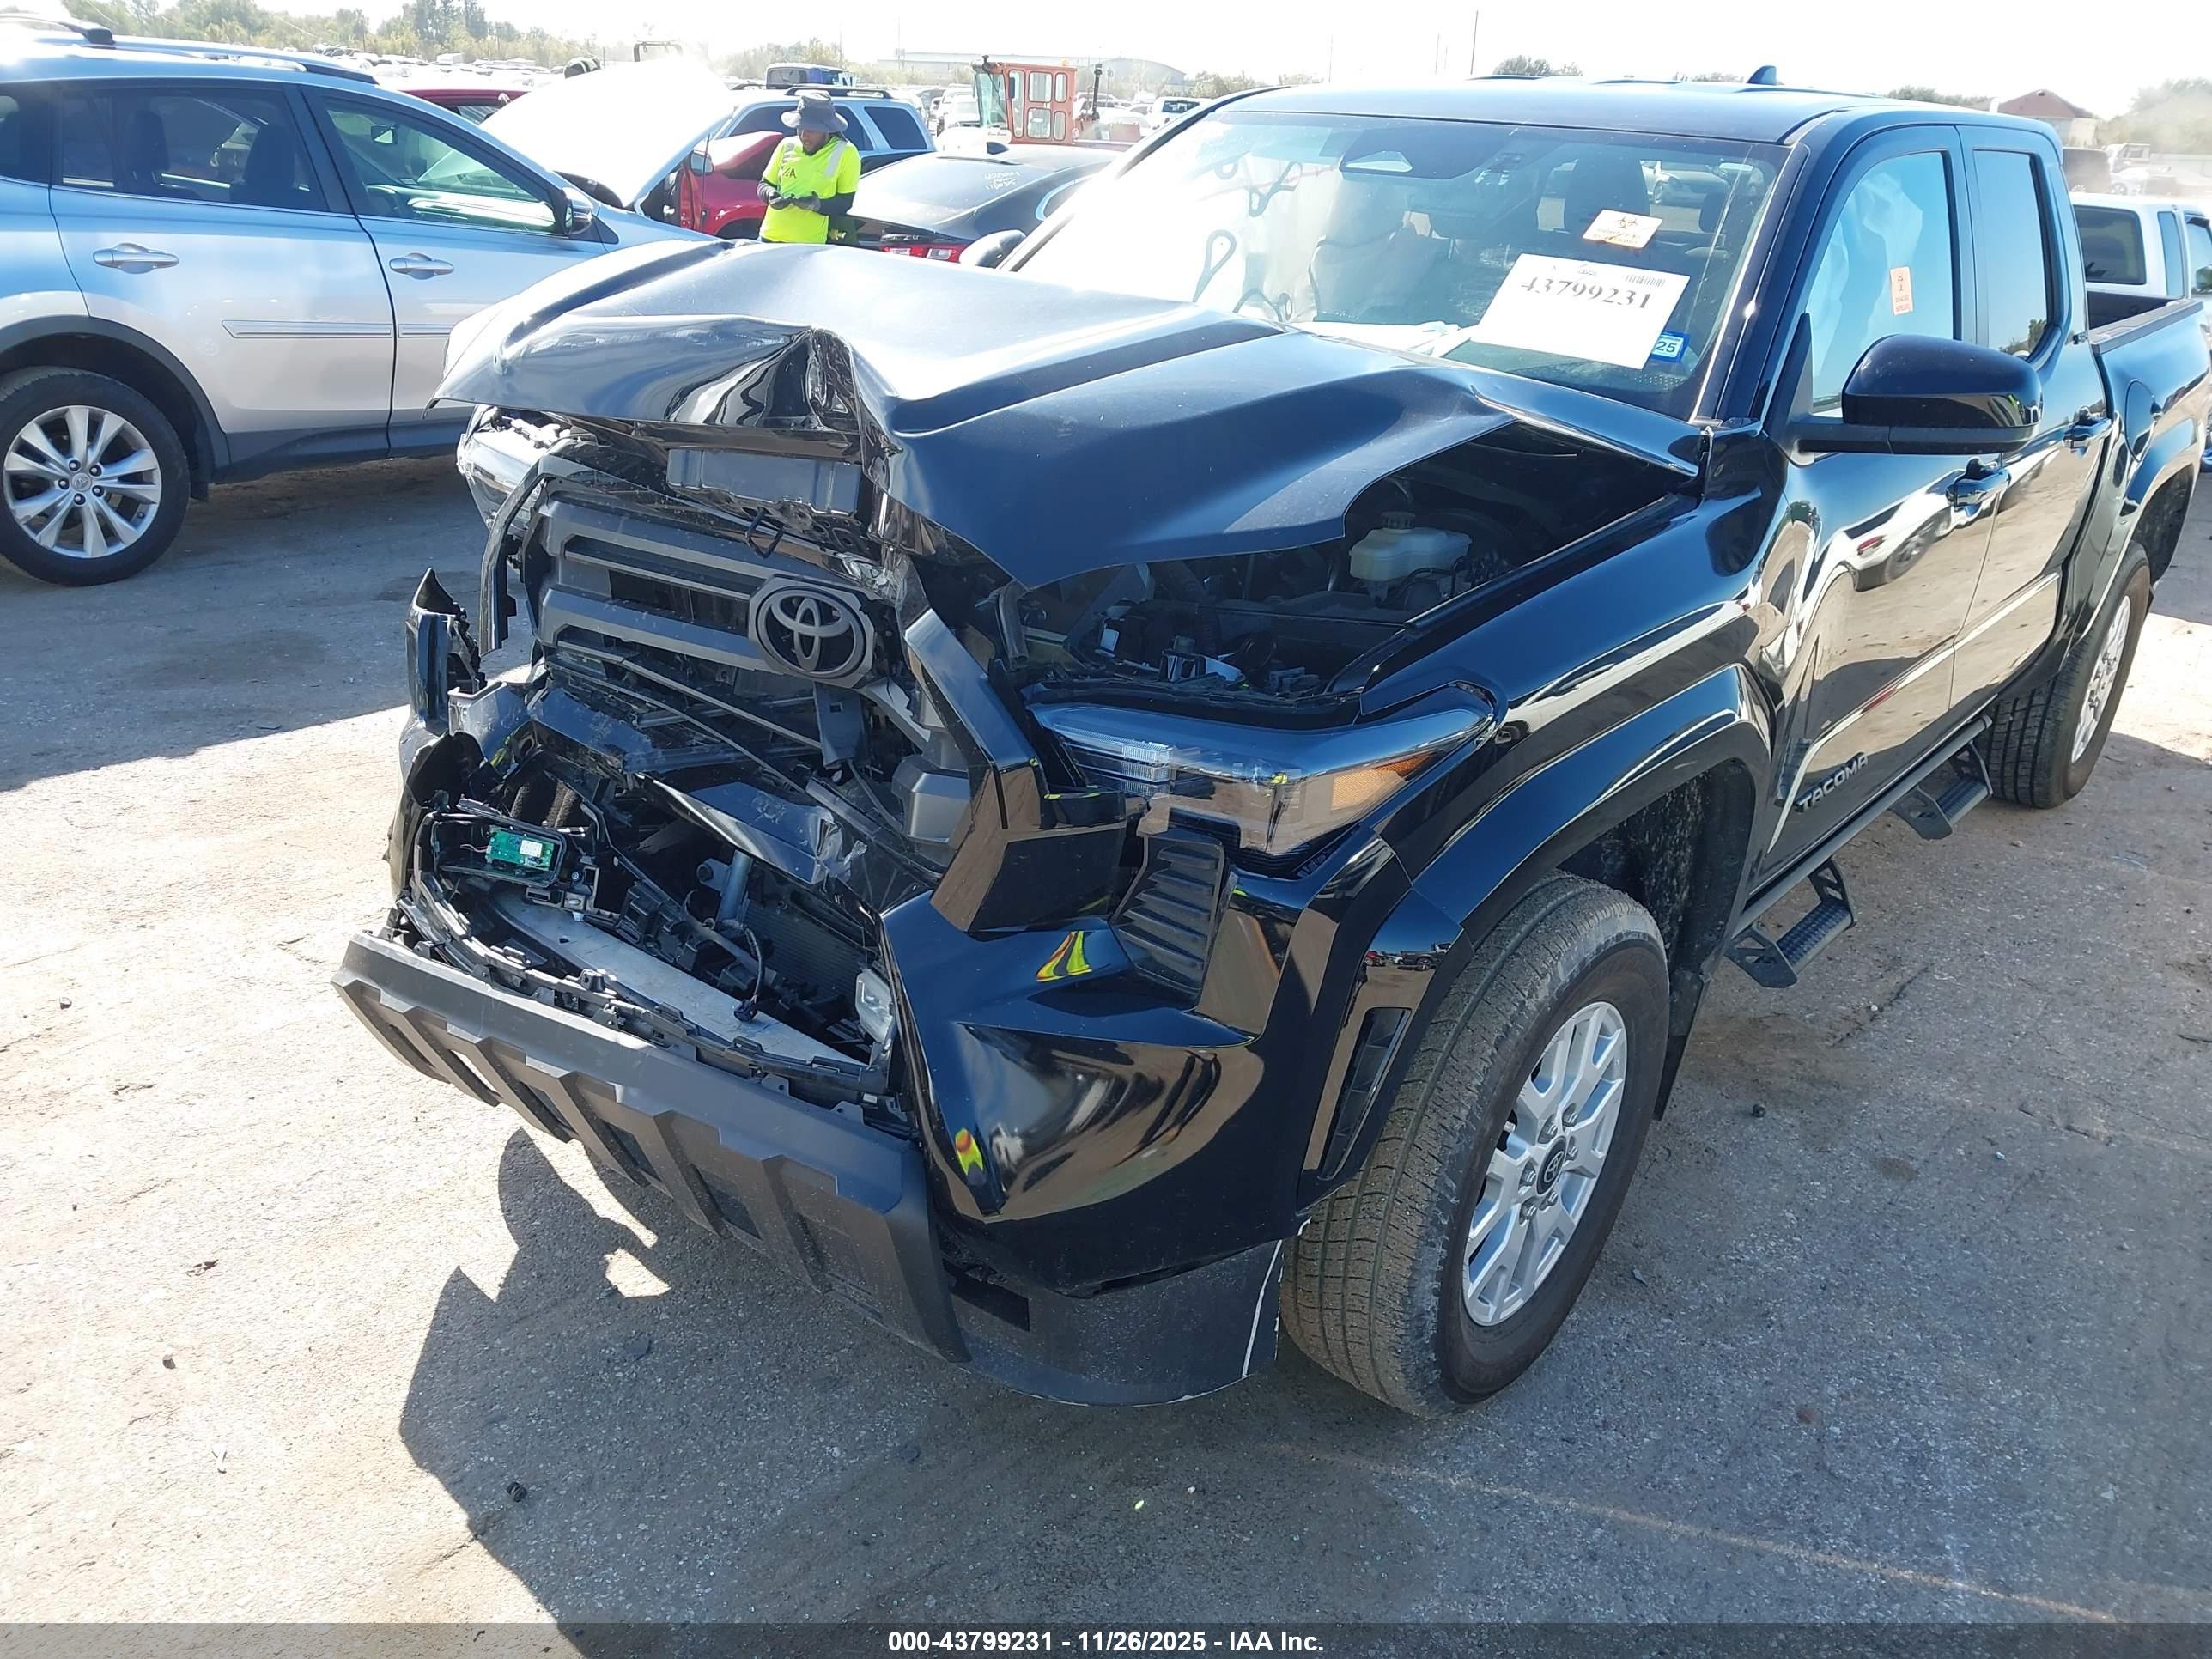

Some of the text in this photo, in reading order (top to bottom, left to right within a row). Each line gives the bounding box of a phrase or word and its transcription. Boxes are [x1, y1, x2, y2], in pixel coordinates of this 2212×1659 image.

[1521, 276, 1652, 309] 43799231
[1655, 340, 1677, 353] 25
[1797, 754, 1869, 810] TACOMA
